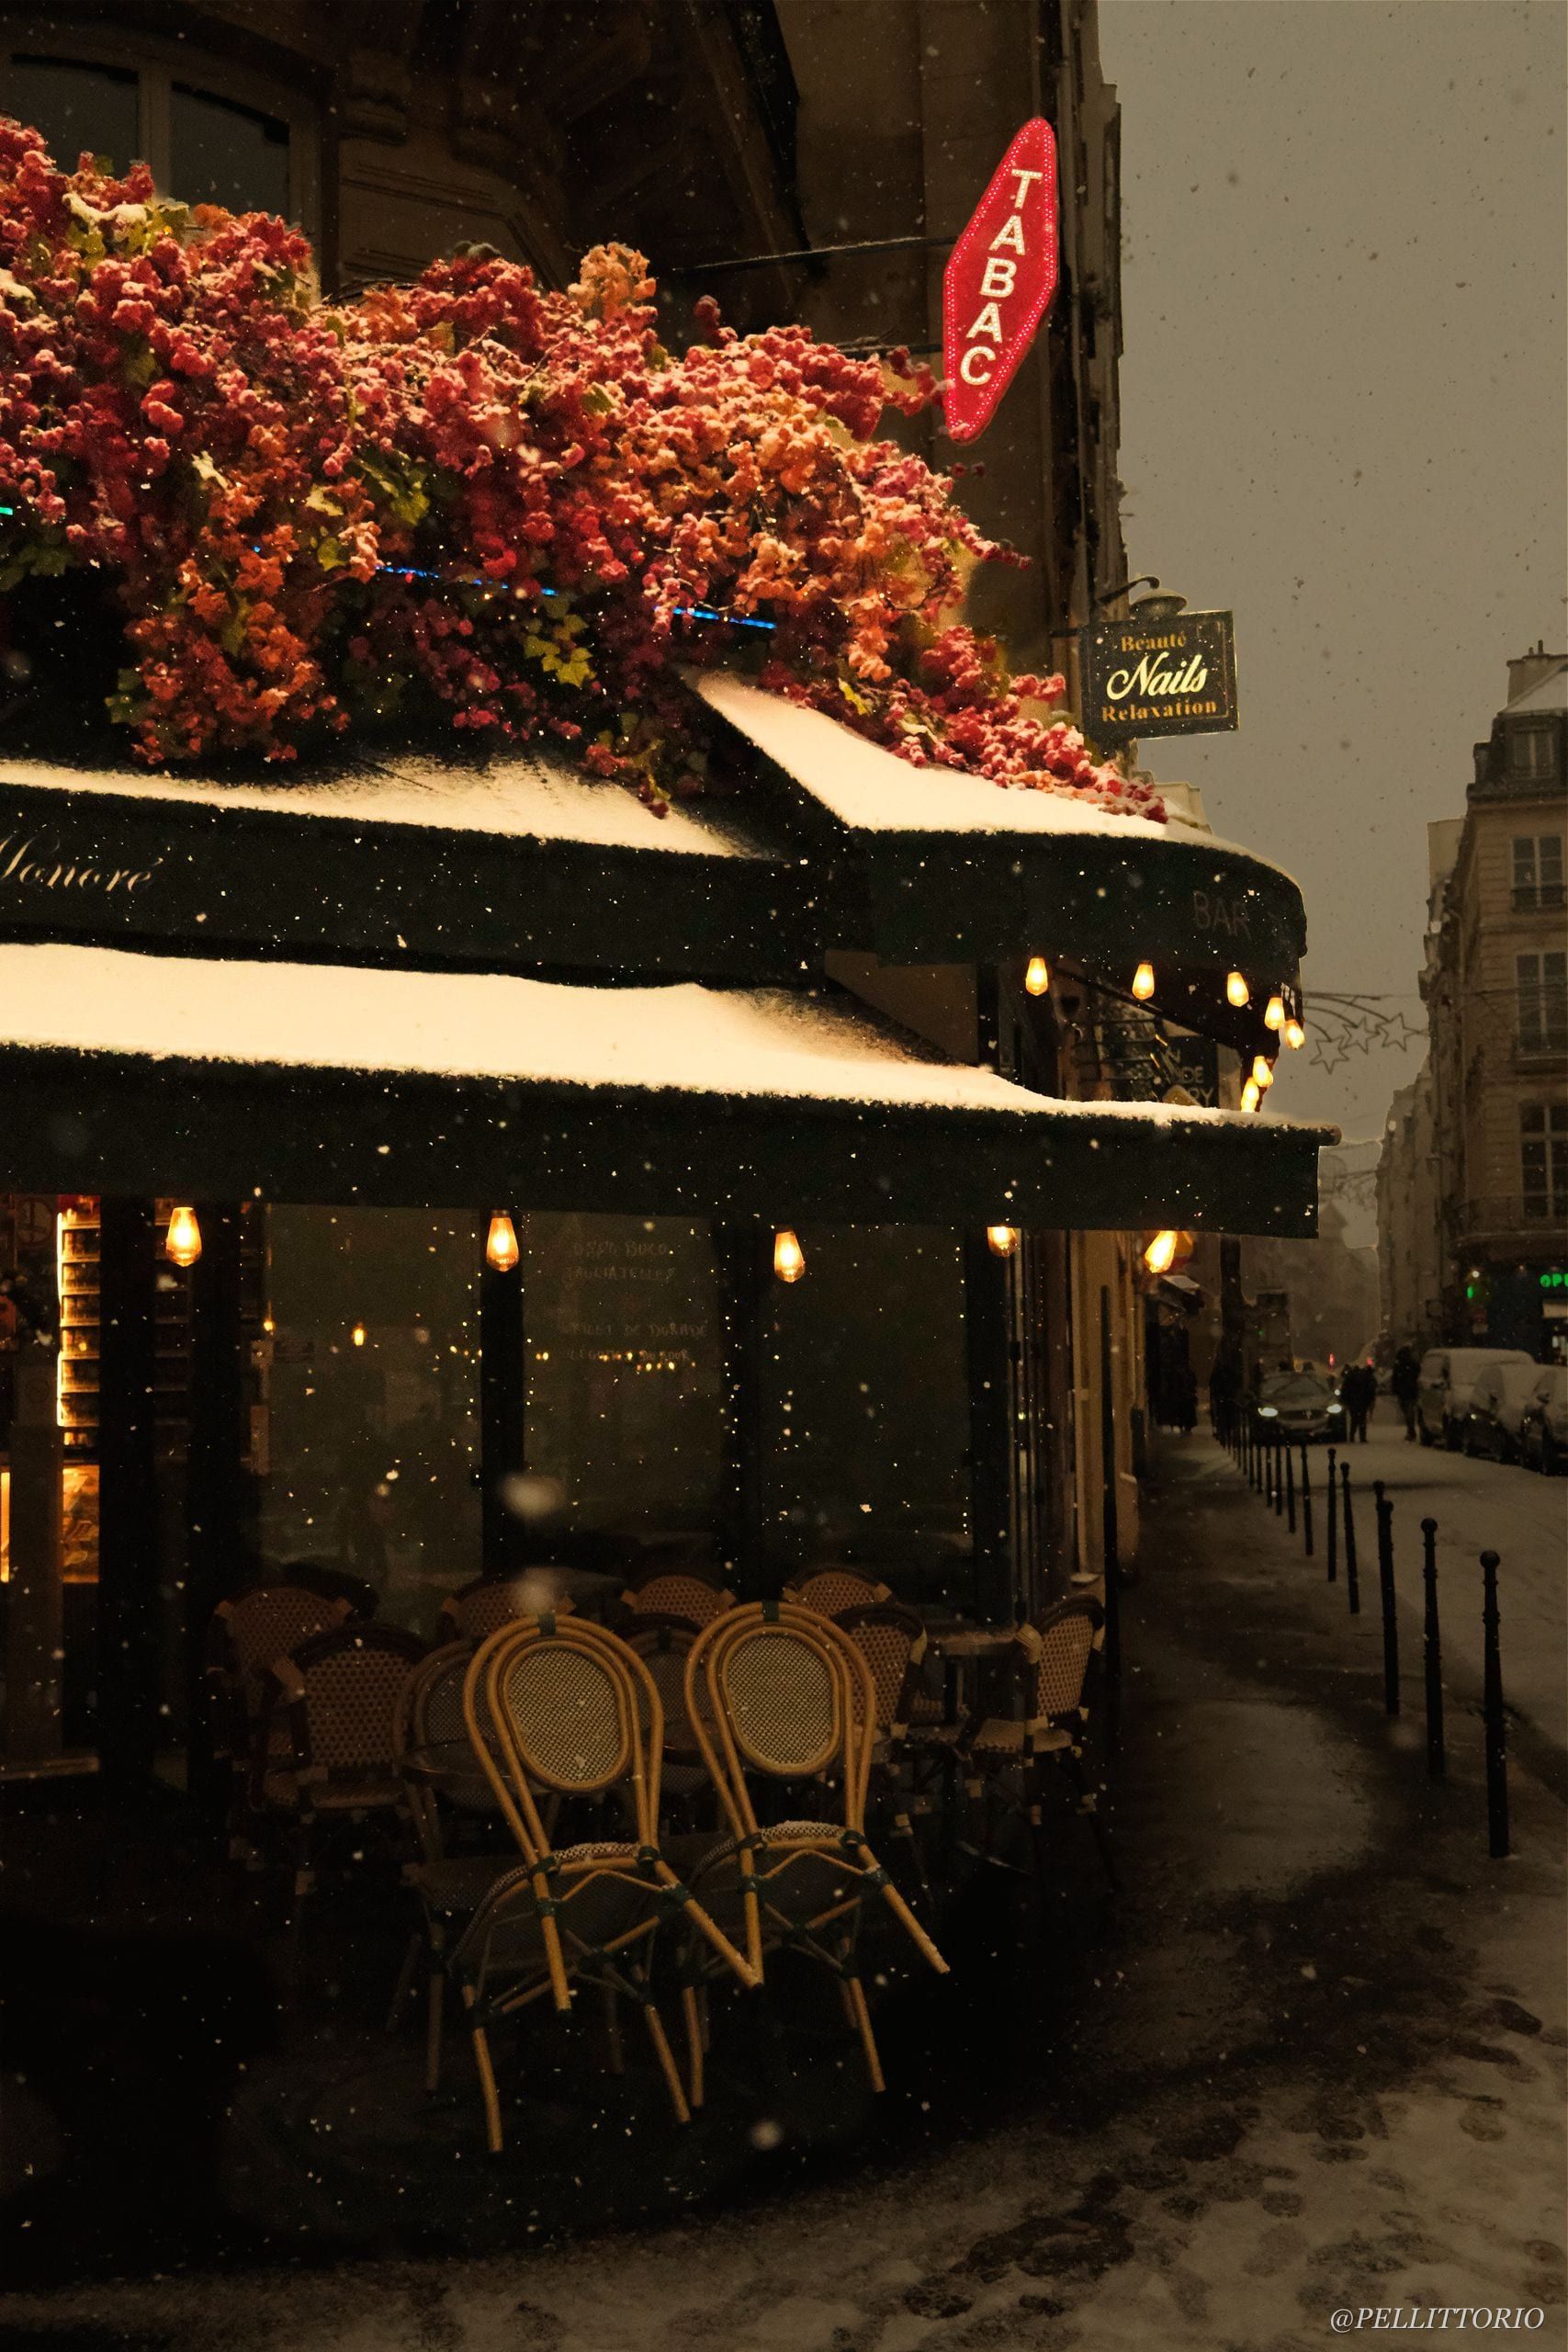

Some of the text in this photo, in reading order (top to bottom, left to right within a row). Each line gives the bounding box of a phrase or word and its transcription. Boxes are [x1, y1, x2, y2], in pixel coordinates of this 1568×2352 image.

[960, 168, 1043, 386] TABAC
[1121, 631, 1188, 652] Beauté
[1106, 650, 1209, 700] Nails
[1101, 698, 1218, 722] Relaxation
[1192, 889, 1253, 942] BAR
